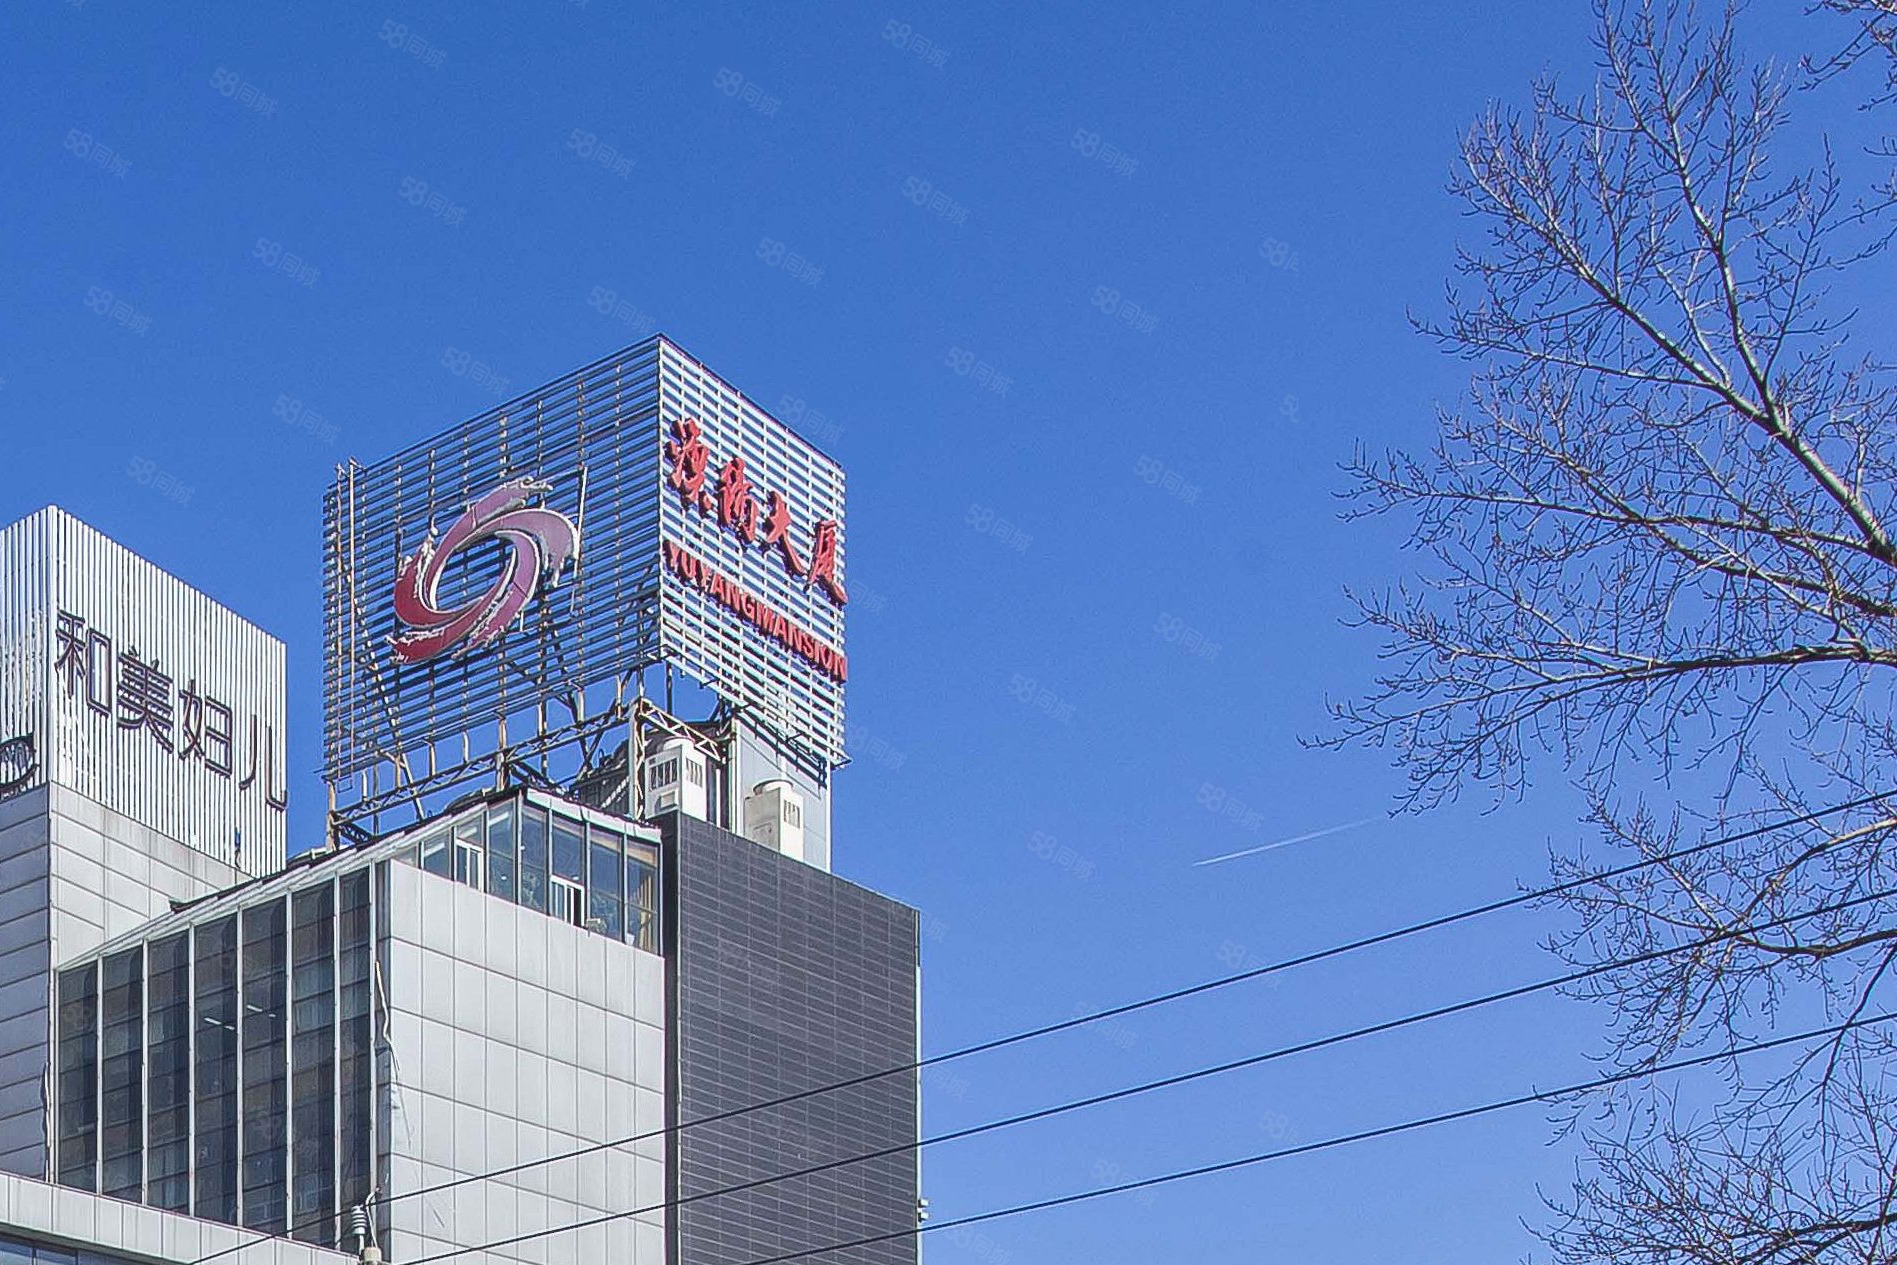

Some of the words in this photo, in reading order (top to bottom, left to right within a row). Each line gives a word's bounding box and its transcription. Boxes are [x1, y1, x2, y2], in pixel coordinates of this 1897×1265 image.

[664, 541, 847, 683] YUYANGMANSION
[54, 610, 287, 810] 和美妇儿
